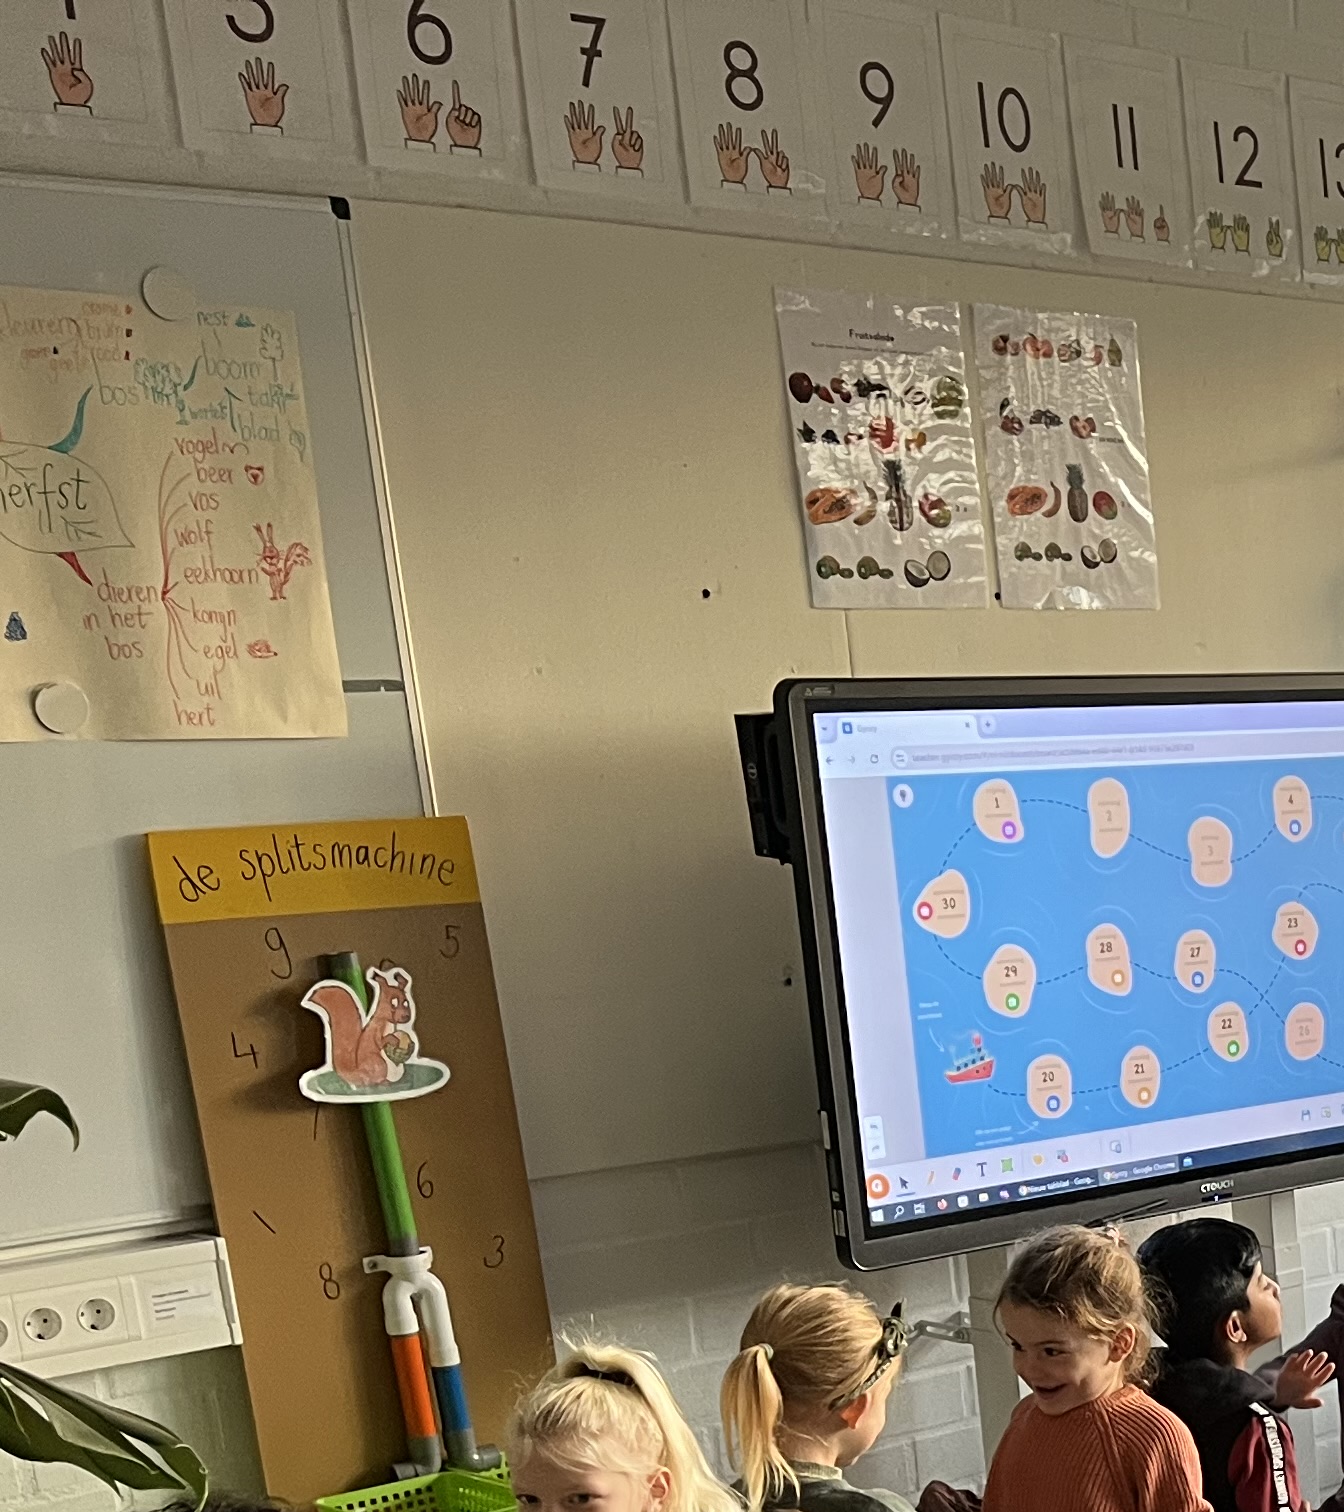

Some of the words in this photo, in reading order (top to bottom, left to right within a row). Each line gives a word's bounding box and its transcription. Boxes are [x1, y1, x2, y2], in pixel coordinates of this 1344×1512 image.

[406, 0, 453, 65] 6
[569, 13, 607, 88] 7
[723, 40, 764, 111] 8
[859, 61, 895, 129] 9
[977, 81, 1031, 153] 10
[1111, 103, 1140, 172] 11
[1213, 121, 1263, 189] 12
[174, 426, 219, 463] vogel
[188, 489, 219, 511] vos
[174, 519, 216, 551] wolf
[106, 630, 145, 660] bos
[203, 634, 239, 671] egel
[173, 854, 221, 904] de
[239, 830, 456, 903] splitsmachine
[264, 927, 292, 980] 9
[439, 925, 461, 959] 5
[231, 1031, 259, 1069] 4
[416, 1160, 434, 1199] 6
[1200, 1178, 1236, 1193] CTOUCH
[484, 1234, 505, 1270] 3
[319, 1262, 341, 1300] 8
